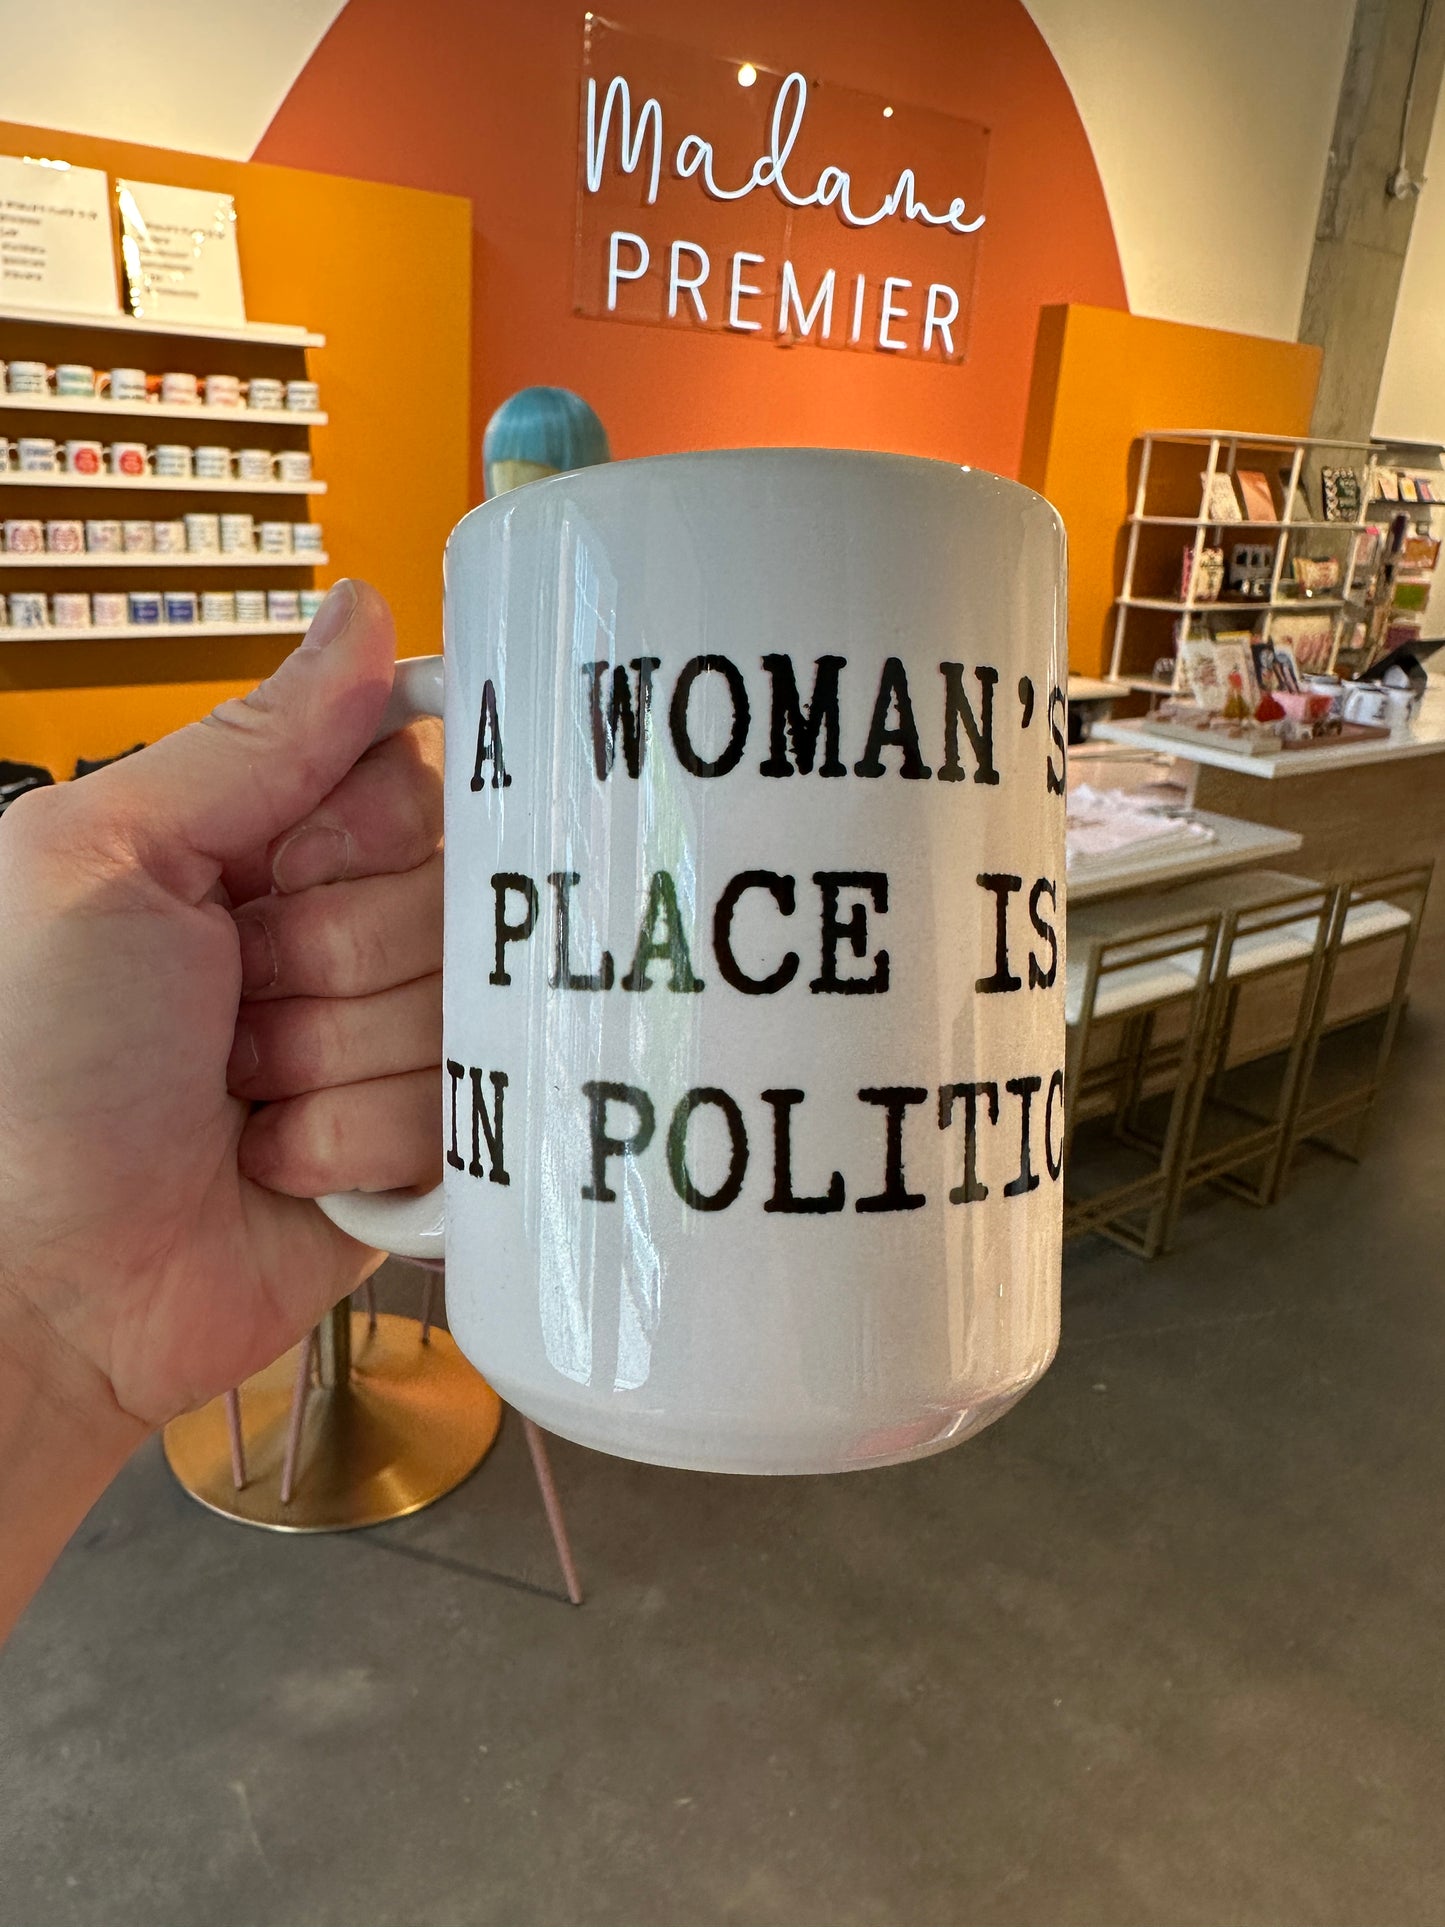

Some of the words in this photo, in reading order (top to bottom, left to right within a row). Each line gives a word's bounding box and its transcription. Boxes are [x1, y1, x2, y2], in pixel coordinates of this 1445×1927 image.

[586, 71, 986, 233] Madame
[606, 231, 960, 355] PREMIER
[470, 679, 513, 792] A
[581, 654, 1067, 796] WOMAN'S
[488, 869, 890, 995] PLACE
[975, 872, 1058, 994] IS
[446, 1058, 511, 1187] IN
